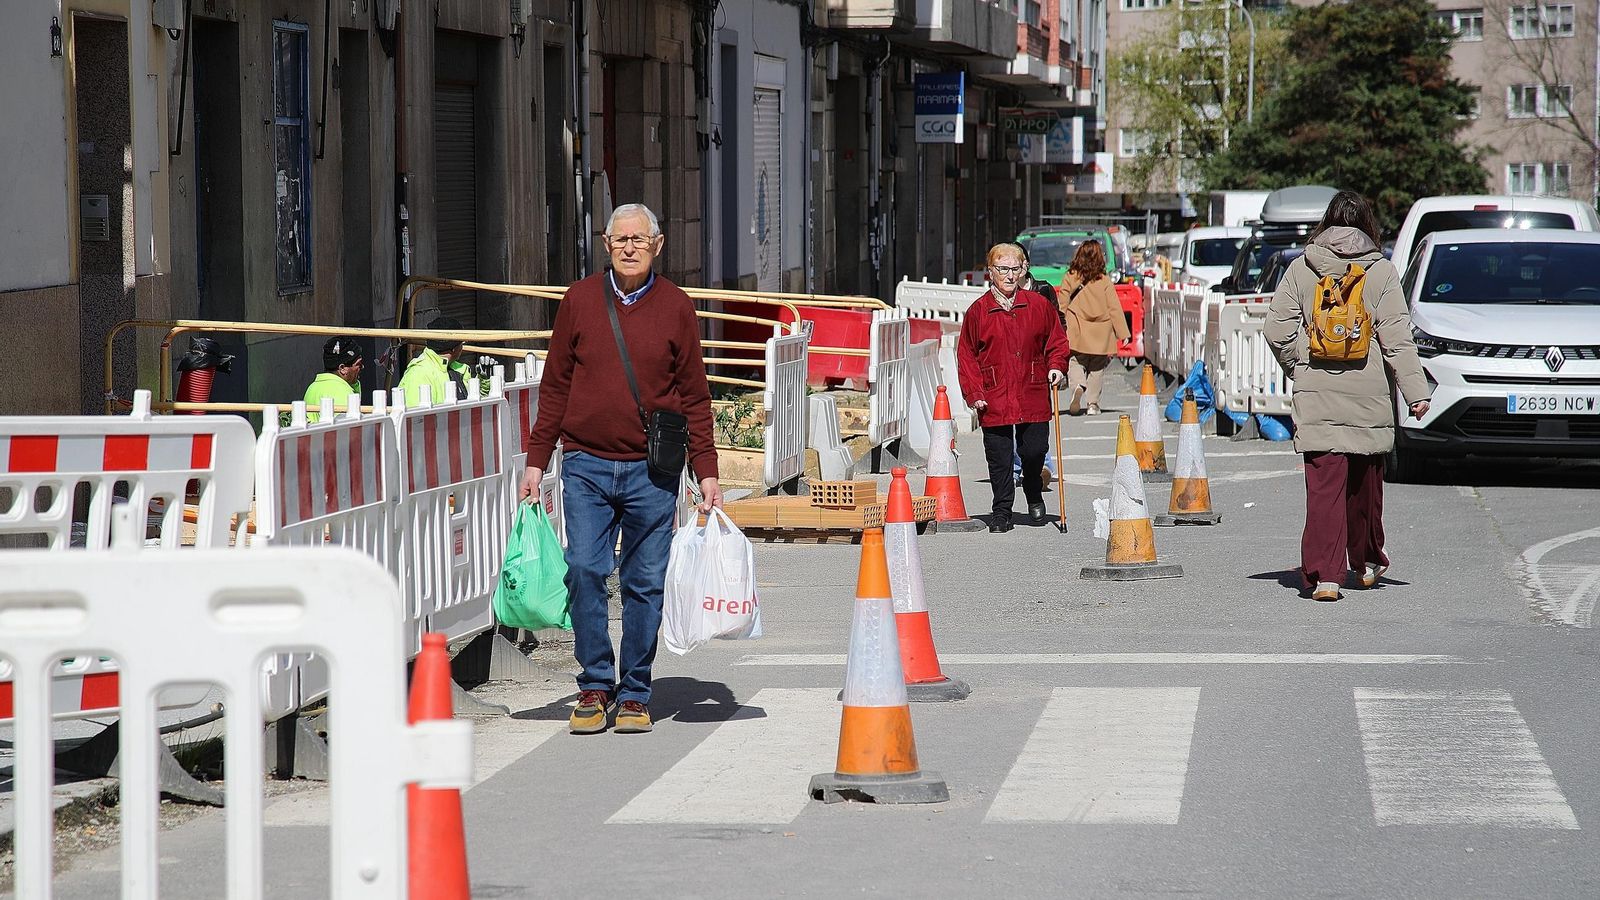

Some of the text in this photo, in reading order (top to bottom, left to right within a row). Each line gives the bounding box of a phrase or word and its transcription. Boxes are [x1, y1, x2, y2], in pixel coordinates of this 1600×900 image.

[917, 95, 961, 105] MARIMAR
[1519, 396, 1595, 411] 2639 NCW
